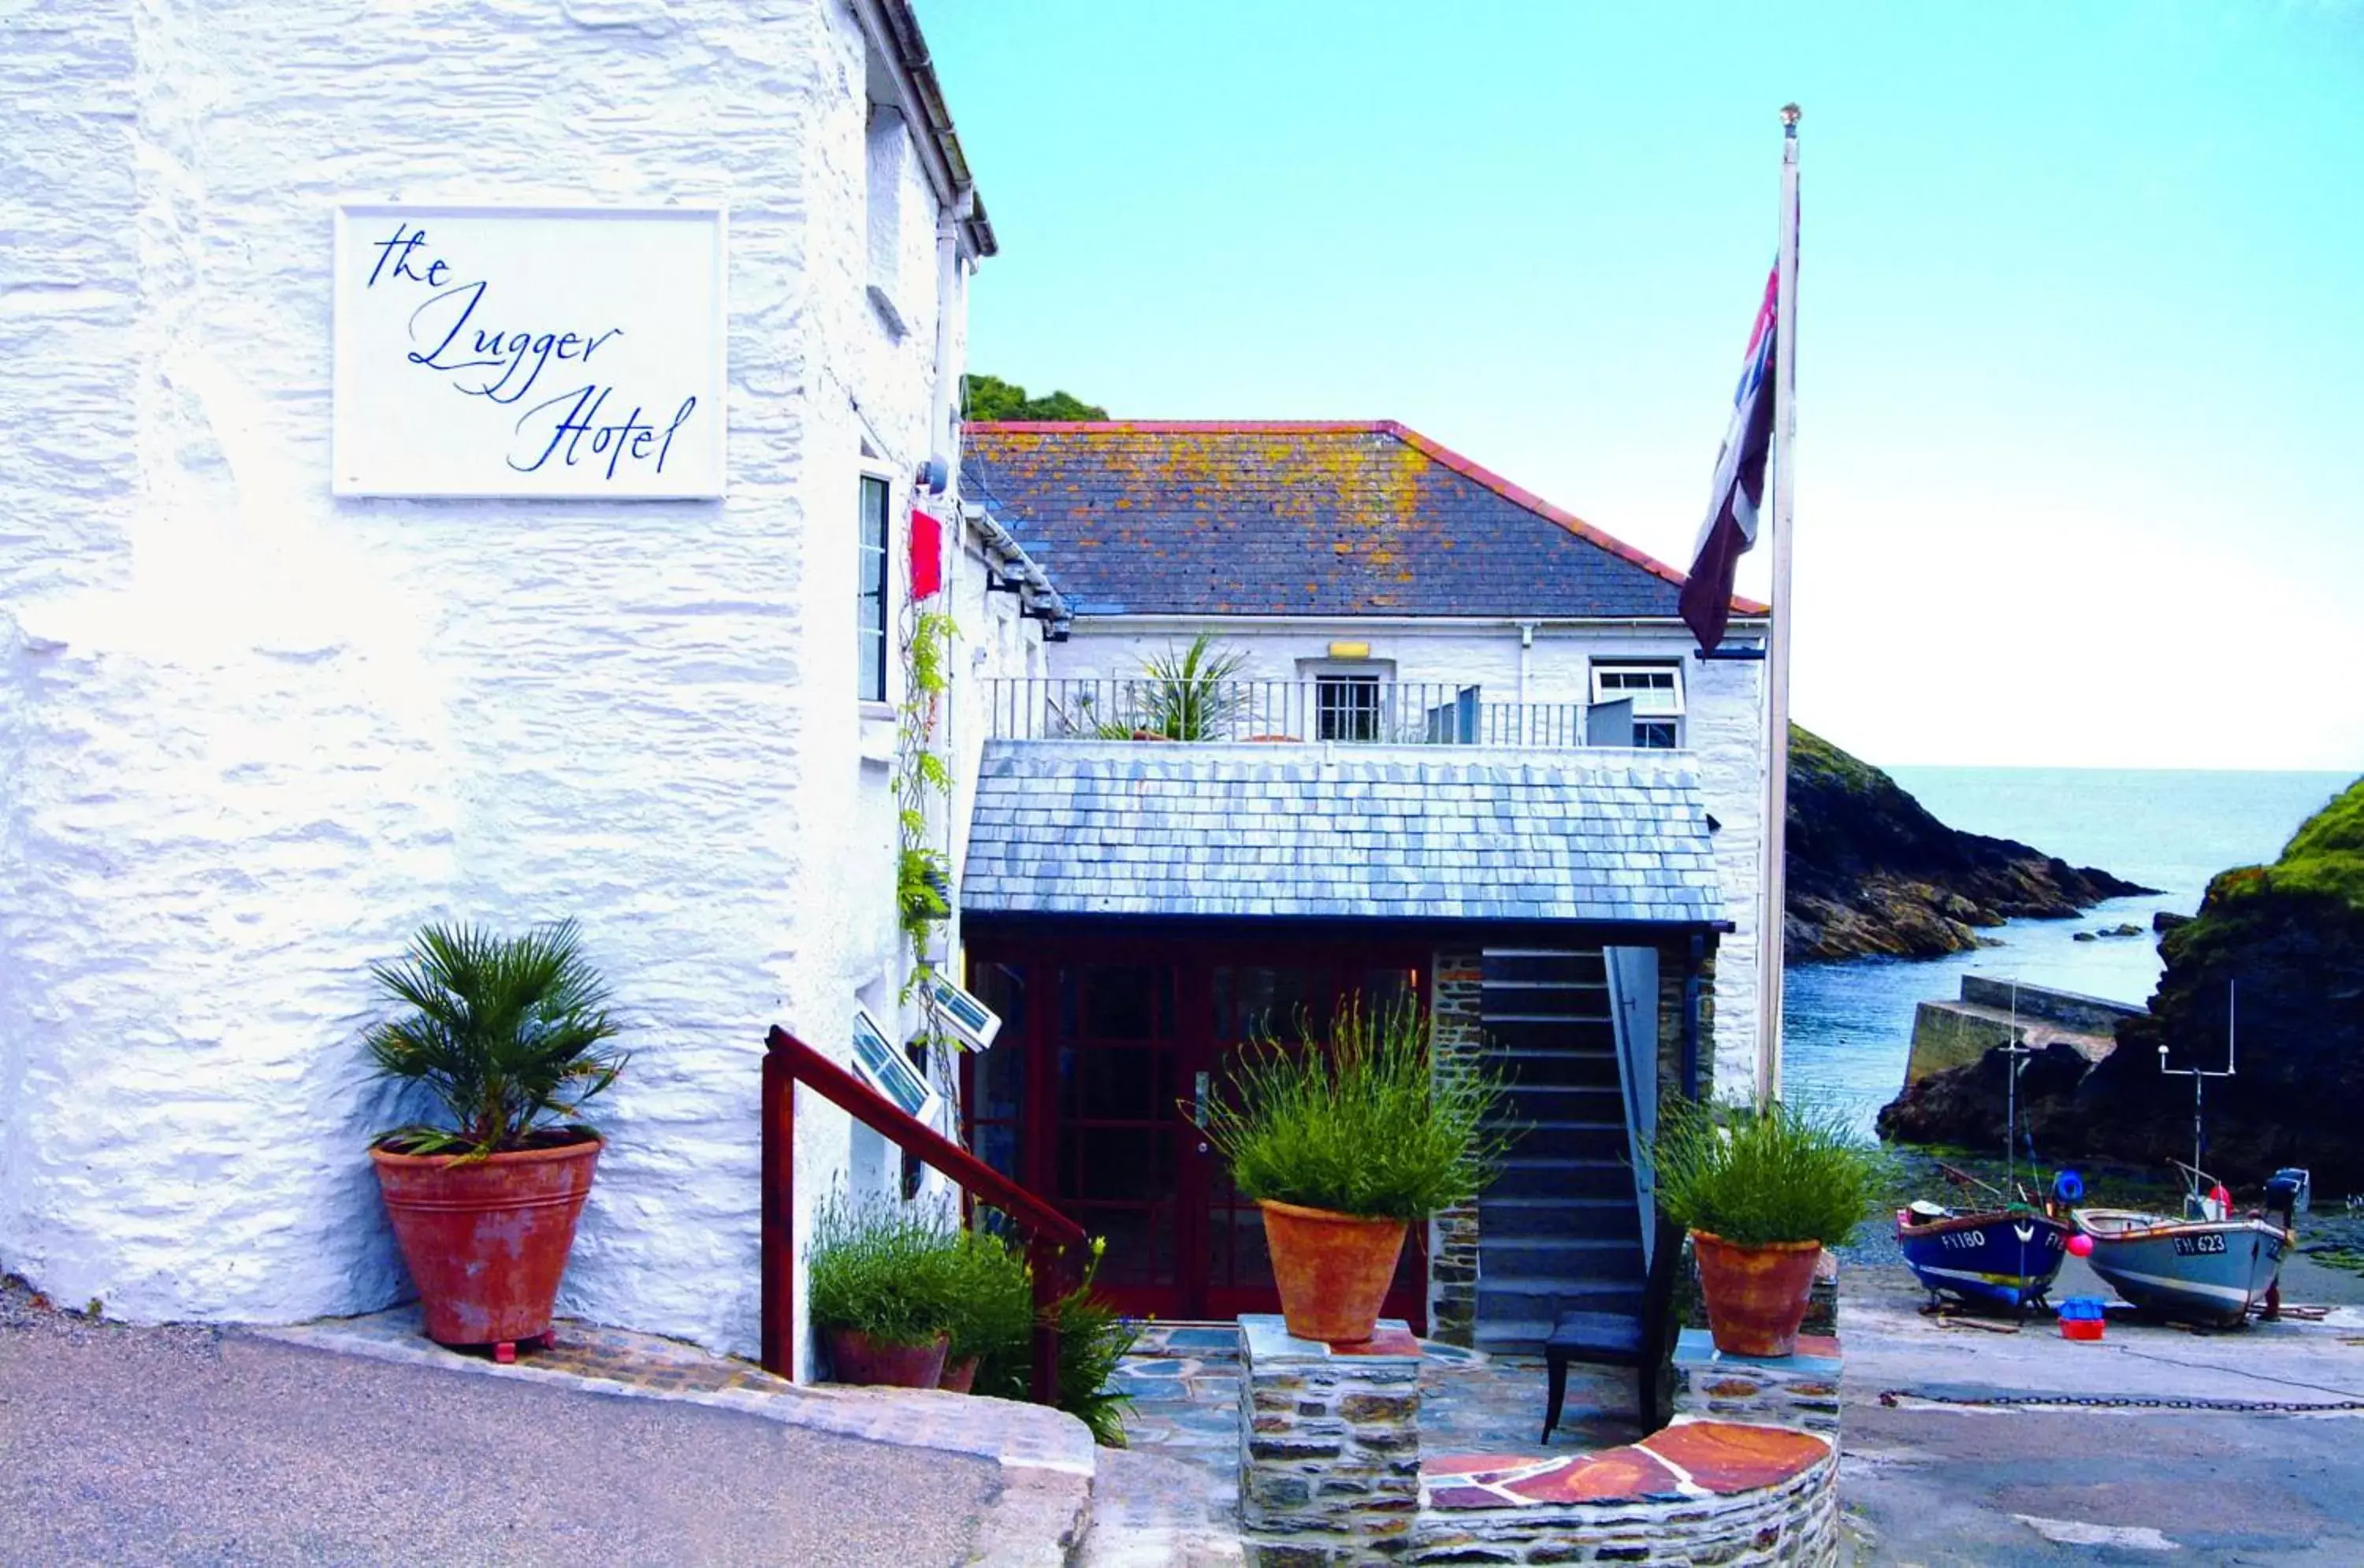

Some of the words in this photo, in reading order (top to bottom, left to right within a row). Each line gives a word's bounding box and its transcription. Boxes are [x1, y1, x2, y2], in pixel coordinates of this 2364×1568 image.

[367, 222, 452, 288] the
[407, 280, 623, 404] Lugger
[506, 384, 697, 480] Hotel
[2198, 1234, 2225, 1252] 623
